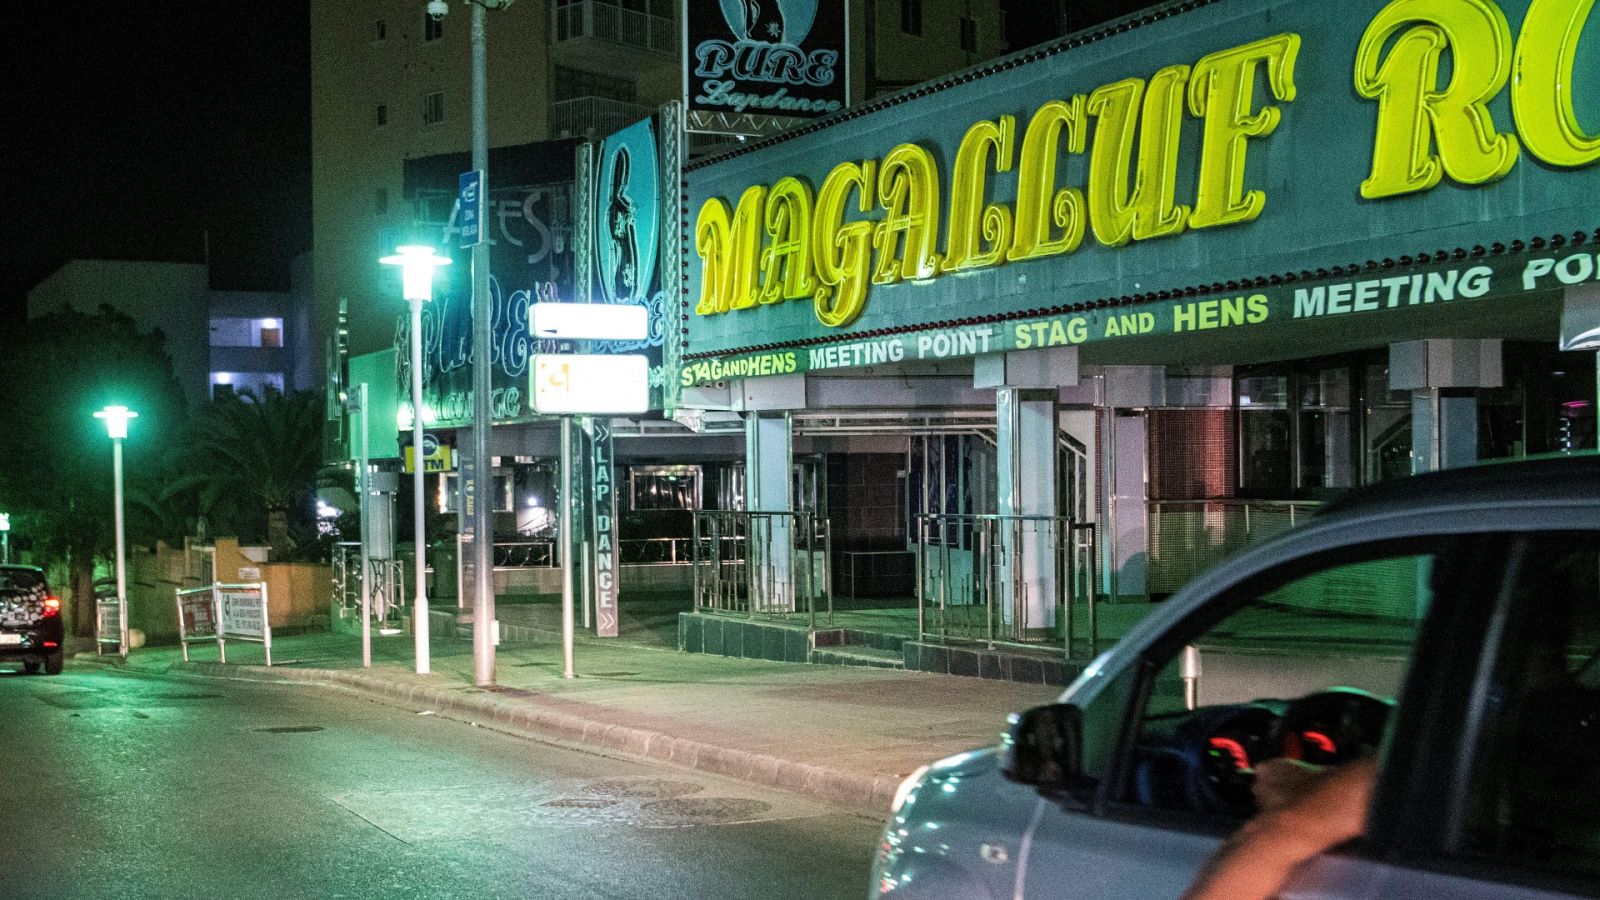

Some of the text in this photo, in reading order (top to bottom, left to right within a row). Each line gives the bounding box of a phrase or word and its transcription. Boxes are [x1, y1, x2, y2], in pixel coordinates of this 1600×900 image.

[695, 39, 839, 87] PURE
[695, 79, 842, 112] Lapdance
[694, 31, 1301, 328] MAGALLUF
[809, 338, 904, 371] MEETING
[918, 328, 993, 360] POINT
[1015, 317, 1088, 350] STAG
[1105, 312, 1156, 338] AND
[1173, 294, 1270, 333] HENS
[1293, 265, 1494, 319] MEETING
[596, 446, 610, 501] LAP
[597, 514, 613, 609] DANCE
